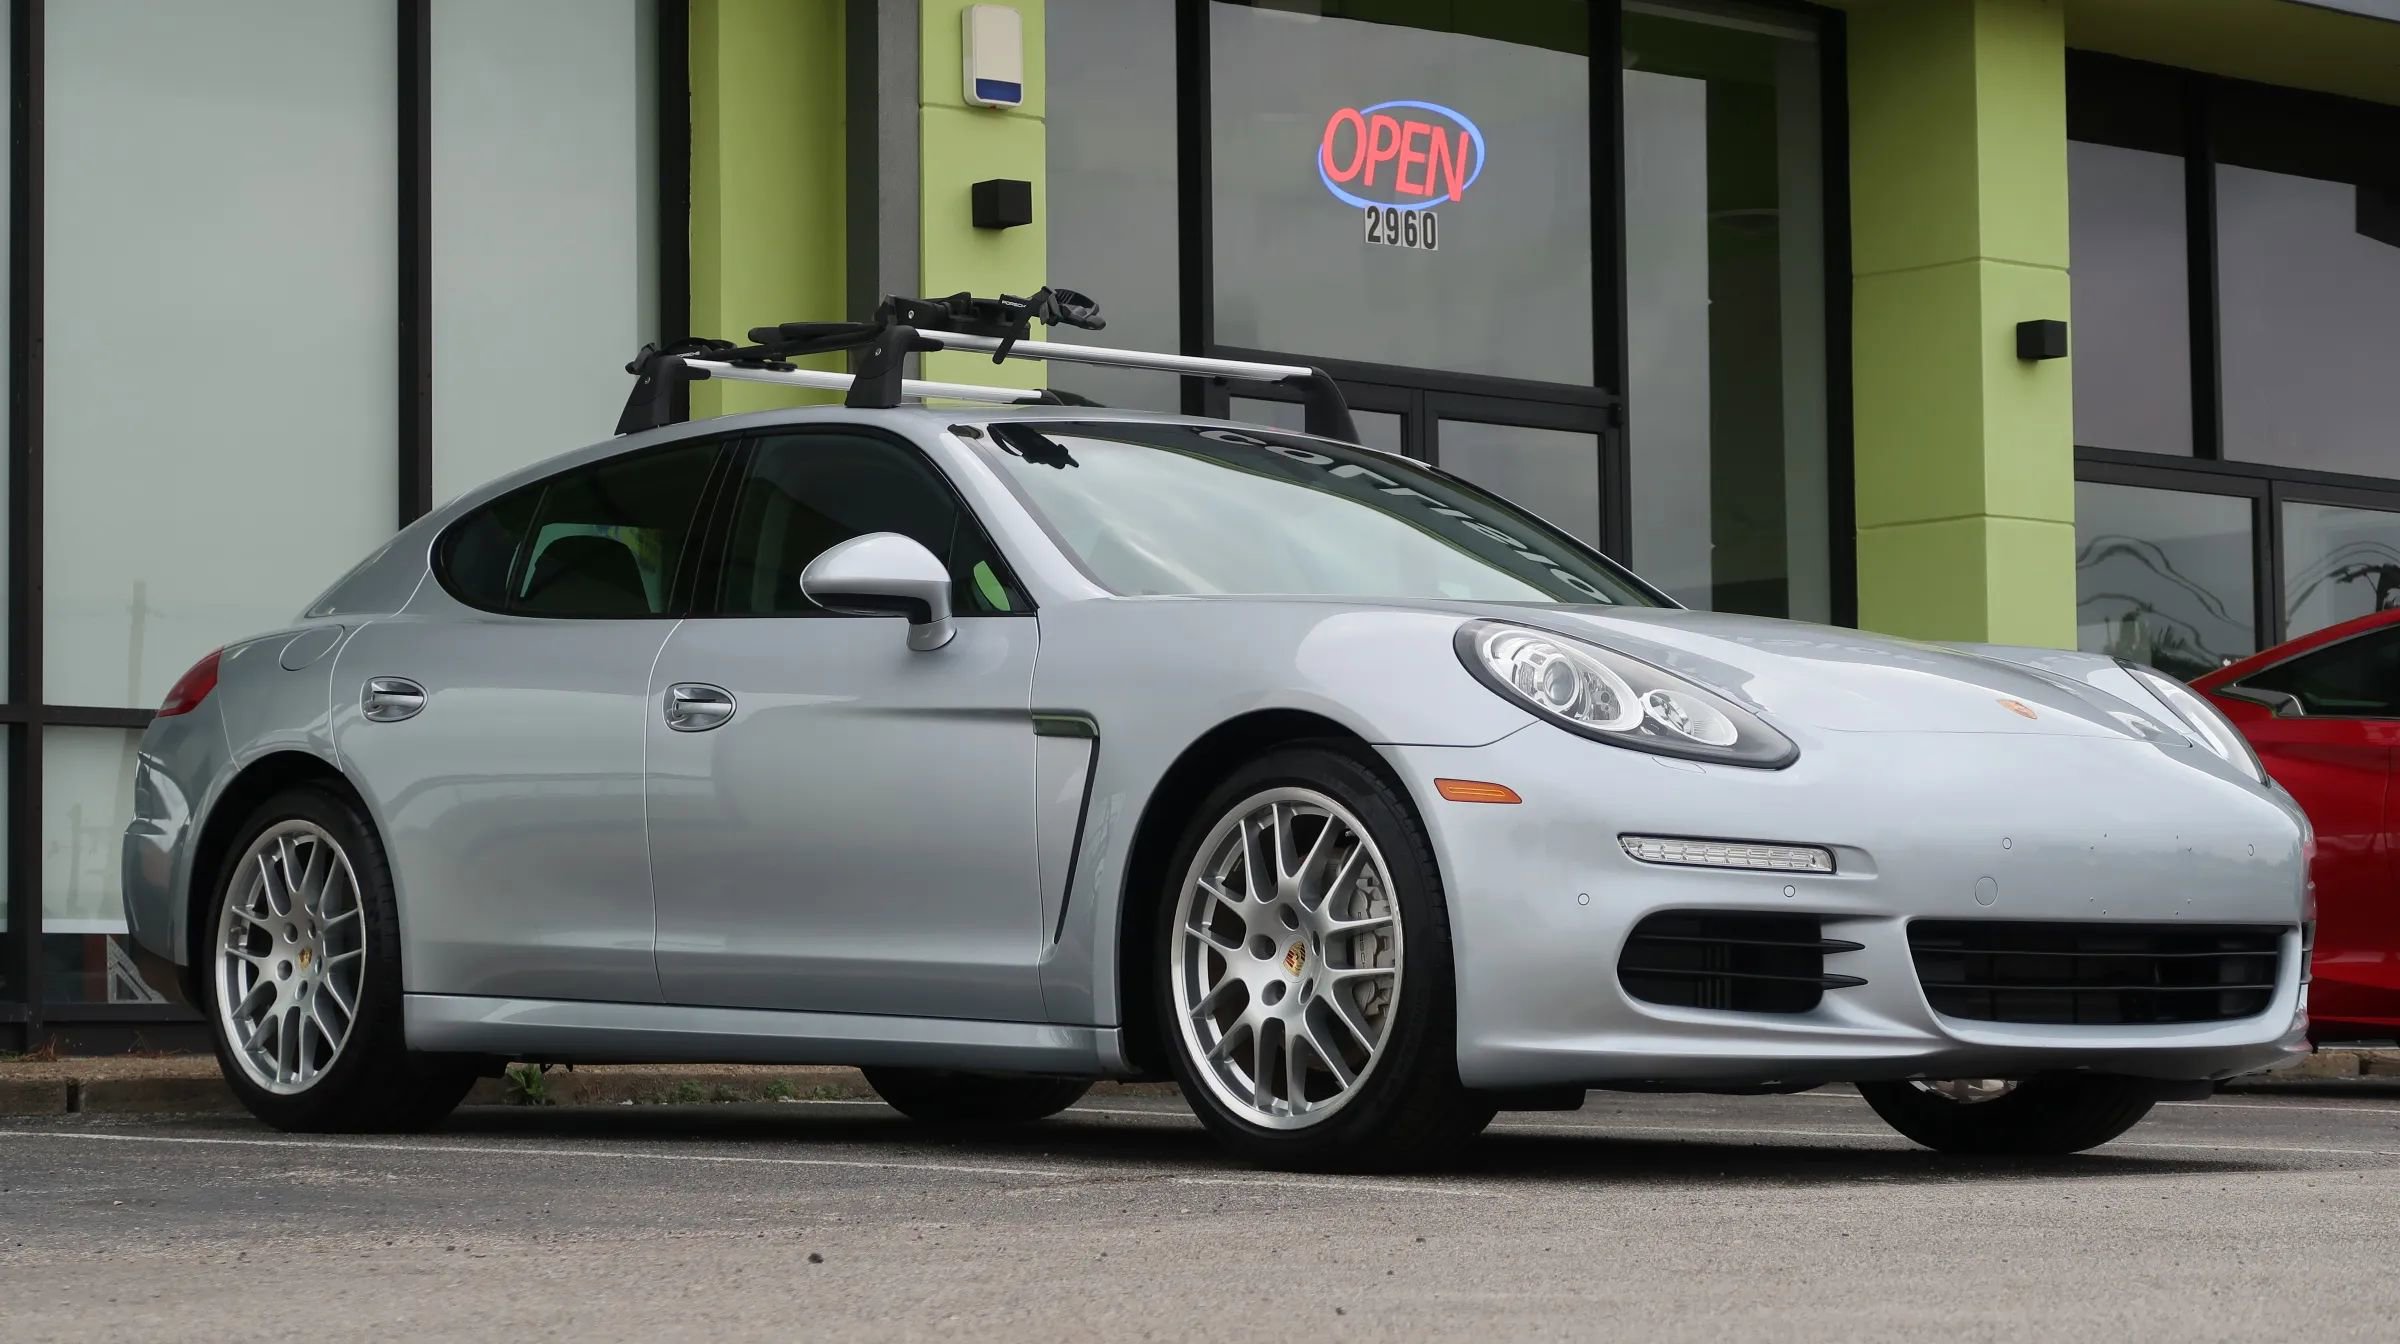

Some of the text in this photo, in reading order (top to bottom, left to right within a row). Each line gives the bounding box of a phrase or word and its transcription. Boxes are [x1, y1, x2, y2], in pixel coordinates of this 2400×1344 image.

[1322, 106, 1470, 202] OPEN
[1366, 205, 1437, 250] 2960
[1001, 300, 1026, 308] PORSCH
